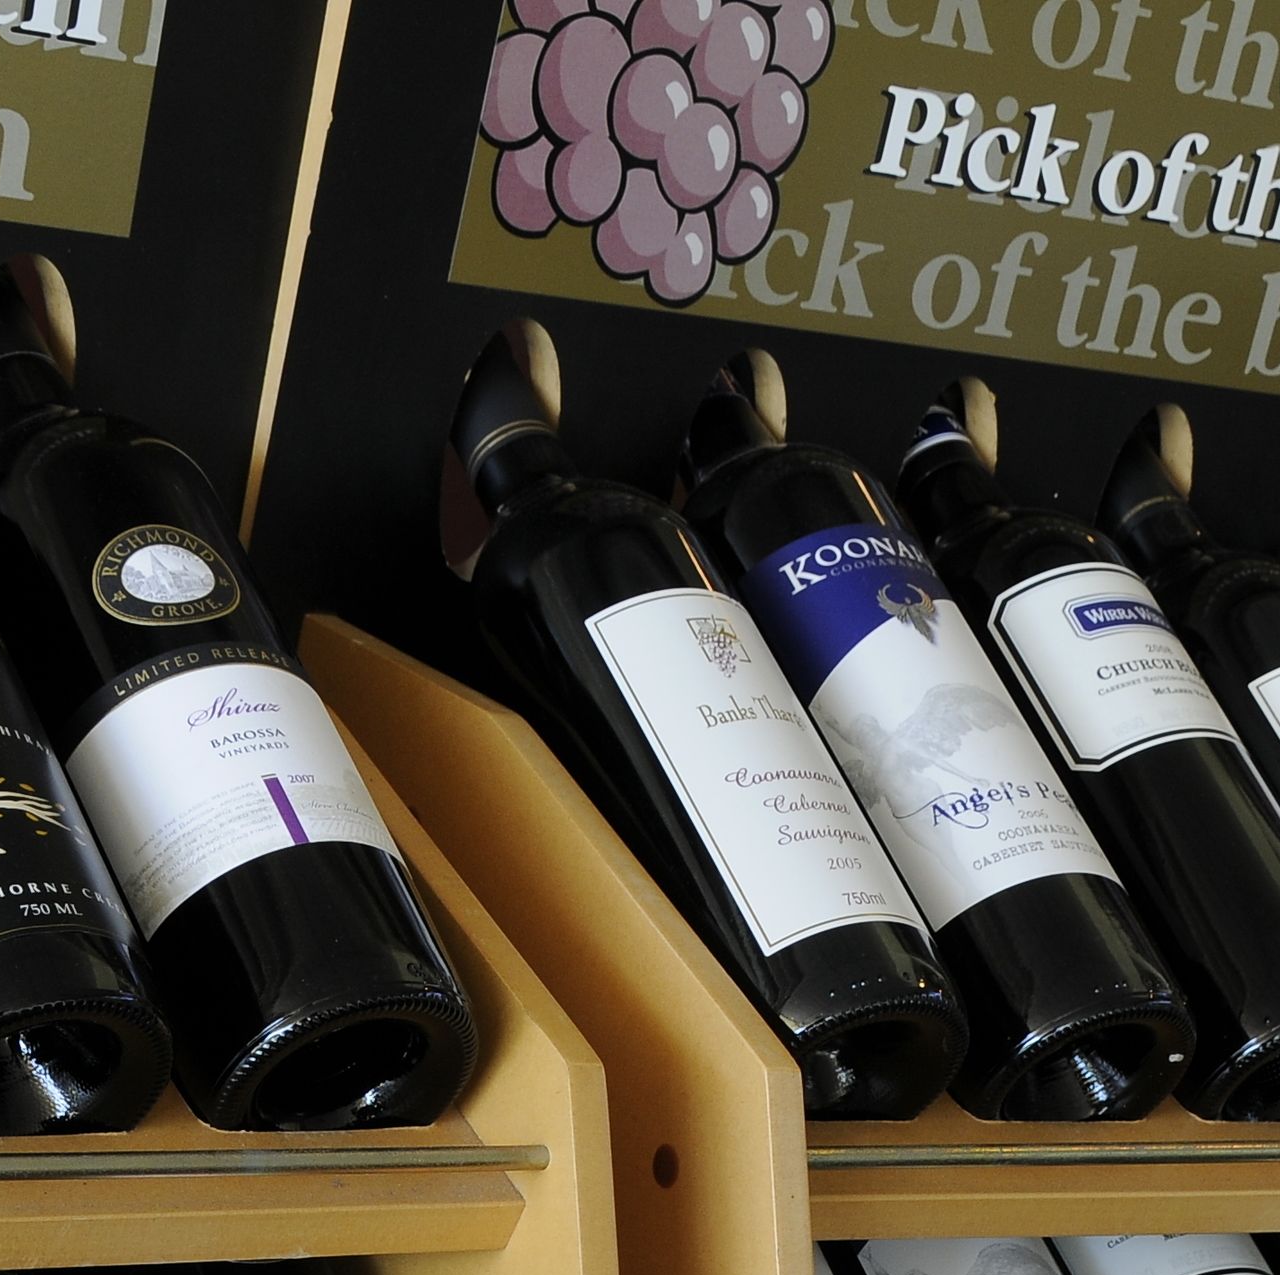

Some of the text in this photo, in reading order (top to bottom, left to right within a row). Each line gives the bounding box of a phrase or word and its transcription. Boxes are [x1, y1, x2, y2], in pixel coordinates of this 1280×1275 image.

[865, 84, 1079, 205] Pick
[1094, 131, 1210, 223] of
[911, 231, 1048, 337] of
[1055, 245, 1222, 364] the
[102, 529, 216, 578] RICHMOND
[1083, 606, 1138, 625] WIRRA
[113, 647, 291, 698] LIMITED RELEASE
[1096, 658, 1172, 681] CHURCH
[187, 688, 281, 732] Shiraz
[696, 695, 758, 728] Banks
[209, 727, 285, 750] BAROSSA
[218, 741, 290, 759] VINEYARDS
[288, 773, 316, 784] 2007
[930, 779, 1031, 829] Angel's
[826, 857, 862, 871] 2005
[972, 840, 1044, 871] CABERNET
[20, 902, 84, 917] 750 ML
[841, 891, 887, 906] 750ml
